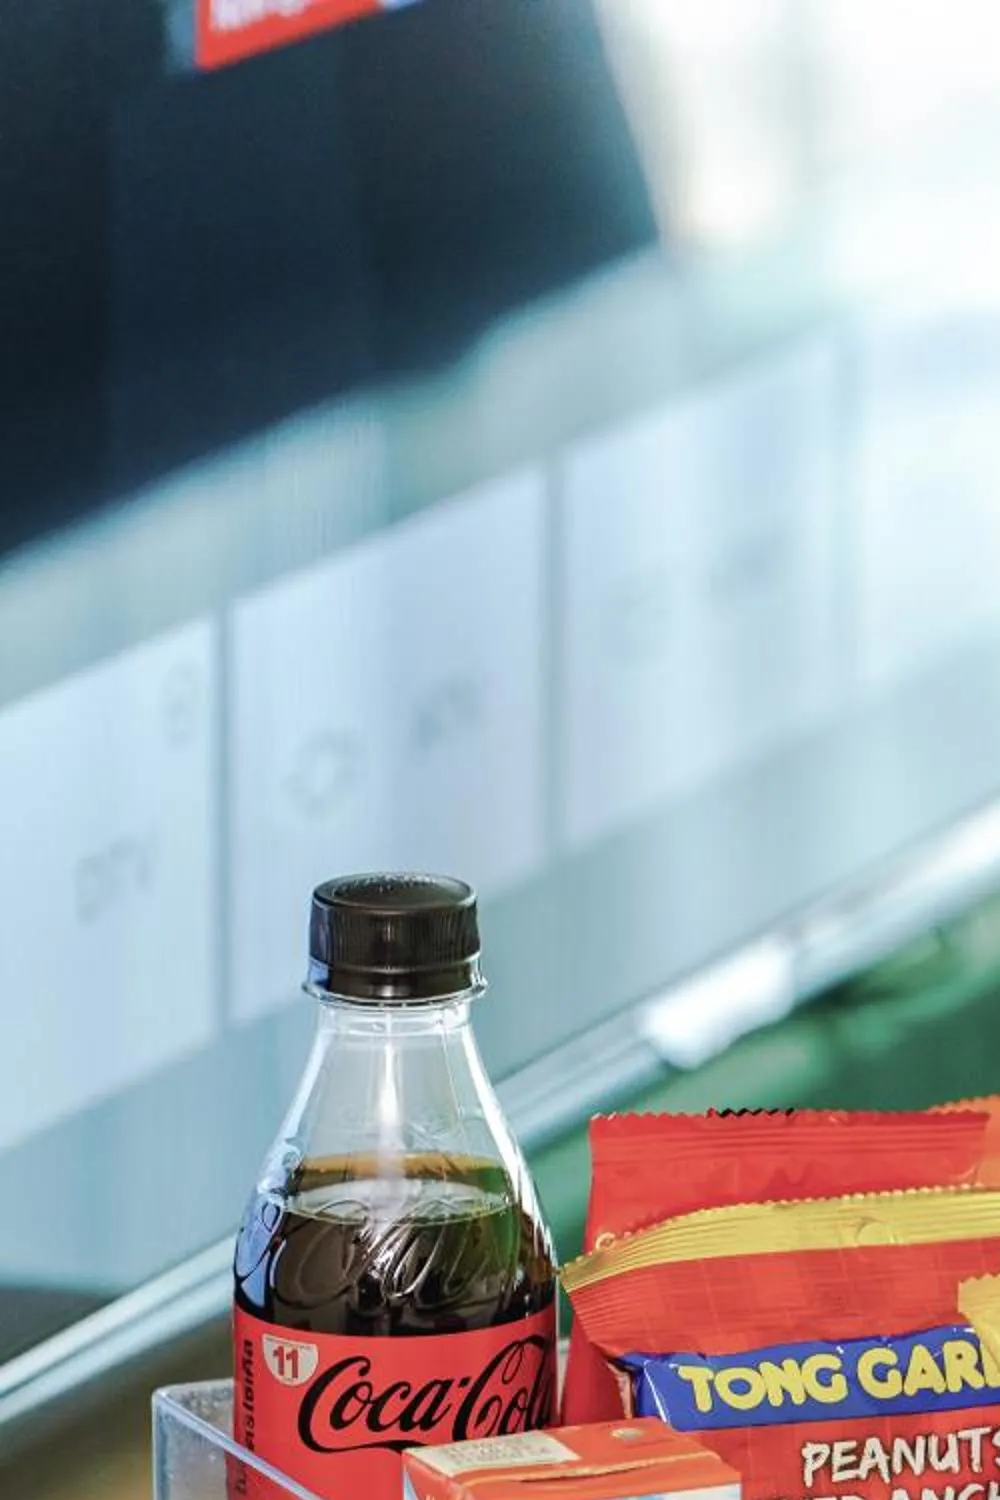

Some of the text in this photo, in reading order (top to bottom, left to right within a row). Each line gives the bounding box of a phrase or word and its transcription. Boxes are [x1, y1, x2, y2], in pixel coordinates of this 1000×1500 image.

[273, 1346, 299, 1379] 11
[677, 1353, 849, 1413] TONG
[297, 1334, 552, 1454] Coca-Col
